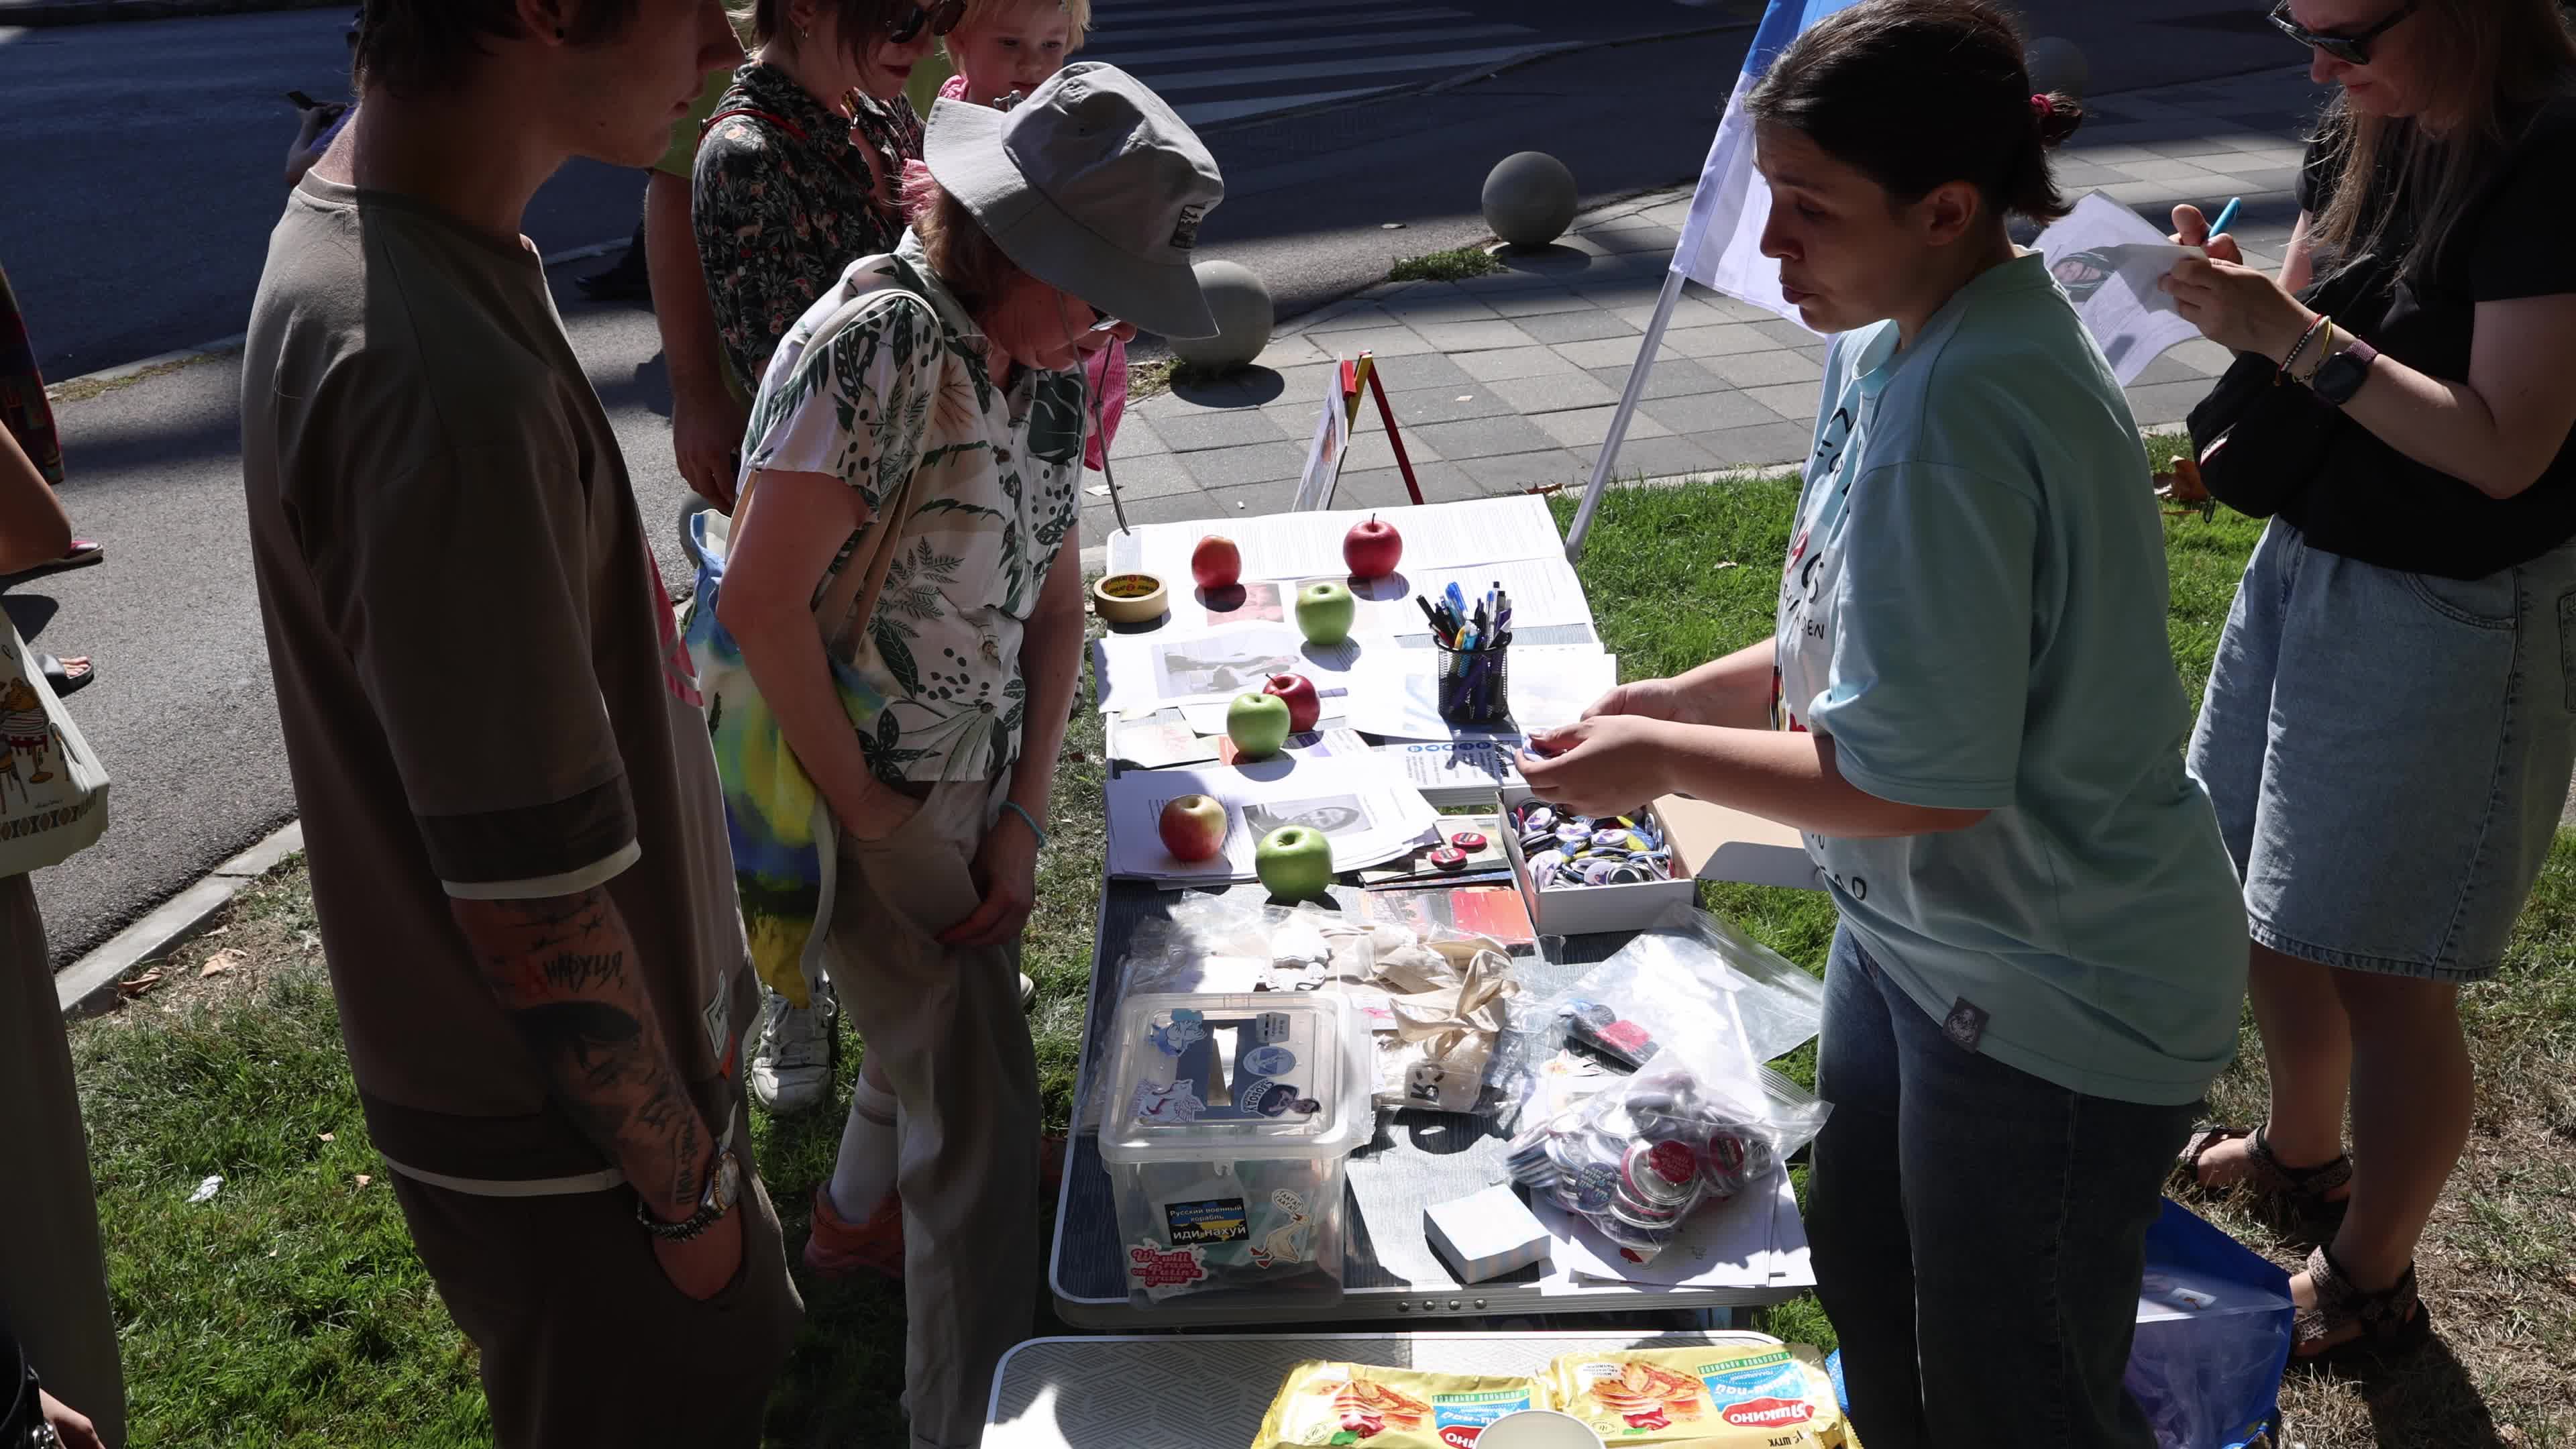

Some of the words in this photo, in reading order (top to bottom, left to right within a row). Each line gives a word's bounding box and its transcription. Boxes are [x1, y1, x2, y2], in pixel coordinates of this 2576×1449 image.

[1246, 1081, 1274, 1111] СВОБОДУ
[1170, 1207, 1203, 1216] Русский
[1205, 1205, 1242, 1213] военный
[1191, 1213, 1224, 1222] корабль
[1173, 1228, 1199, 1240] иди
[1204, 1224, 1246, 1236] нахуй
[1131, 1249, 1160, 1262] We
[1162, 1252, 1189, 1262] will
[1148, 1264, 1200, 1277] Putin's
[1729, 1403, 1807, 1423] Яшкино
[1768, 1436, 1792, 1447] ШТУК
